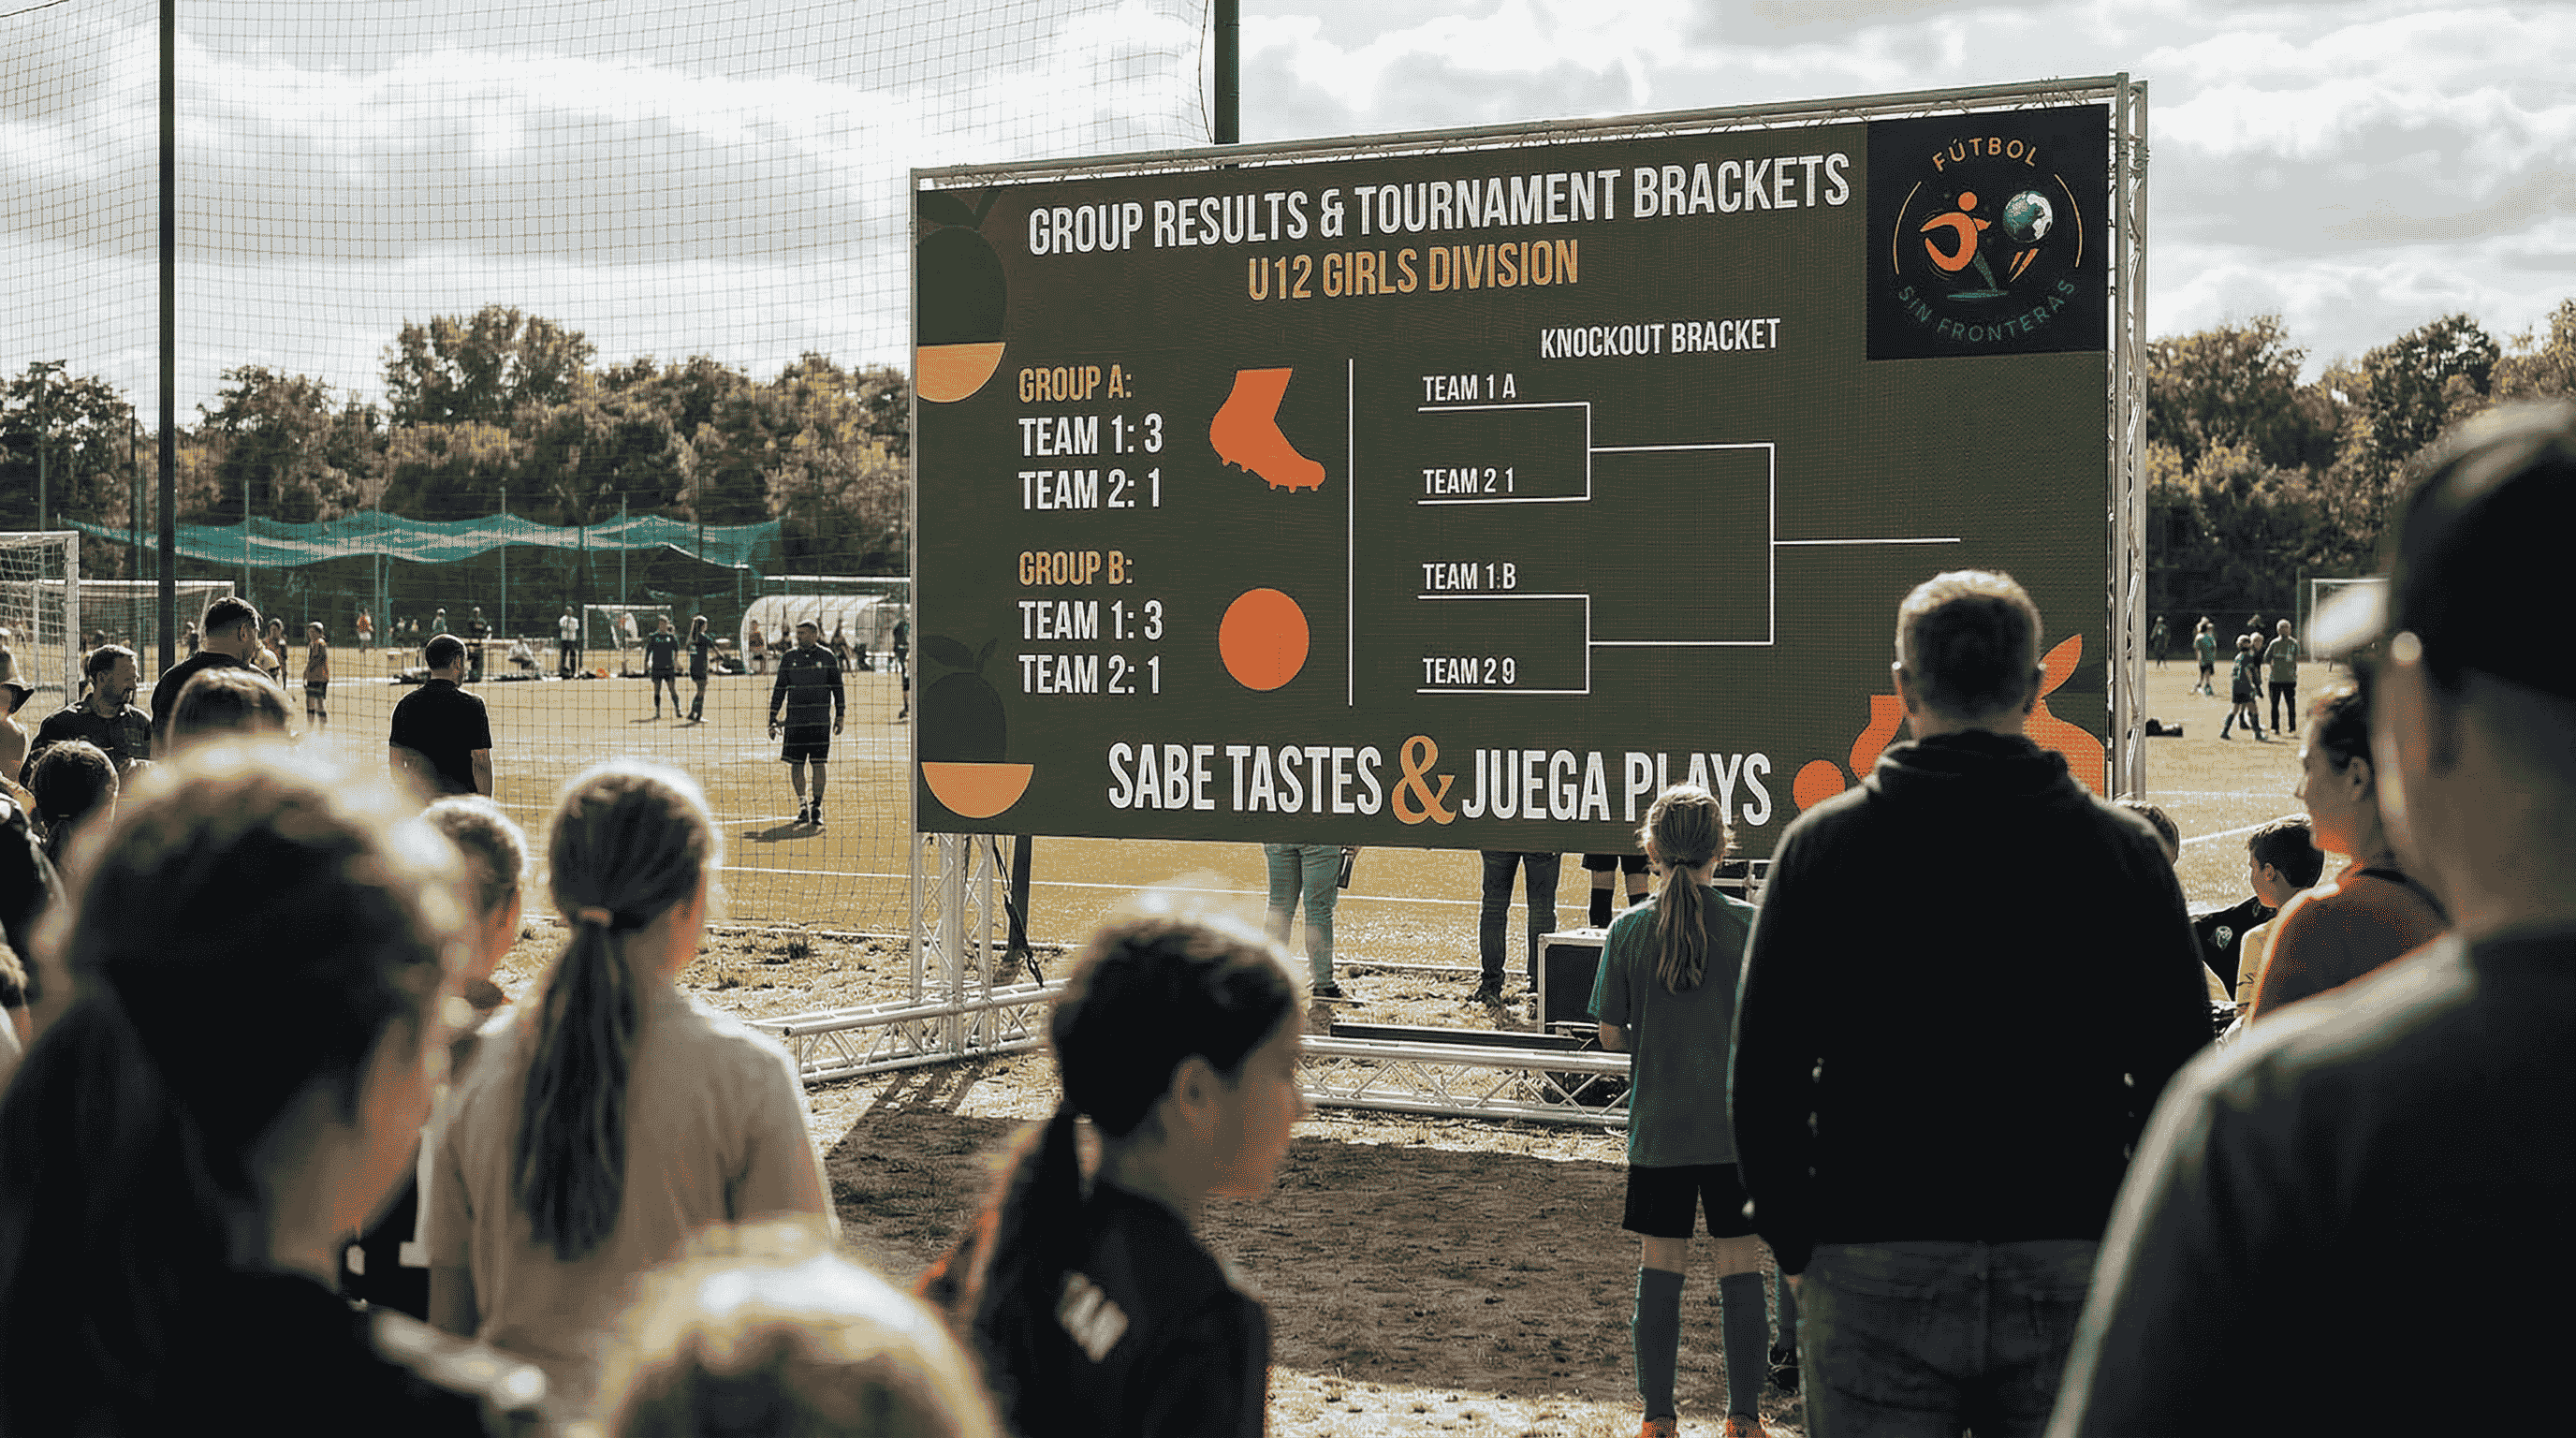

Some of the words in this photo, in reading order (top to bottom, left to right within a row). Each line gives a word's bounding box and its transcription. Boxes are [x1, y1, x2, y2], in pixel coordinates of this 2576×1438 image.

[1932, 137, 2037, 172] FÚTBOL
[1029, 202, 1143, 256] GROUP
[1153, 190, 1310, 248] RESULTS
[1320, 188, 1345, 238] &
[1354, 168, 1621, 235] TOURNAMENT
[1633, 152, 1851, 219] BRACKETS
[1248, 254, 1312, 301] U12
[1323, 248, 1418, 298] GIRLS
[1428, 239, 1578, 292] DIVISION
[1899, 286, 1932, 322] SIN
[1938, 280, 2074, 341] FRONTERAS
[1541, 323, 1665, 359] KNOCKOUT
[1671, 317, 1781, 354] BRACKET
[1018, 365, 1101, 404] GROUP
[1107, 364, 1133, 399] A:
[1422, 374, 1478, 402] TEAM
[1486, 374, 1495, 400] 1
[1501, 373, 1516, 399] A
[1017, 416, 1099, 457] TEAM
[1111, 414, 1135, 455] 1:
[1144, 413, 1164, 454] 3
[1017, 469, 1098, 510] TEAM
[1107, 468, 1136, 509] 2:
[1148, 467, 1161, 507] 1
[1422, 467, 1478, 494] TEAM
[1484, 467, 1497, 493] 2
[1505, 466, 1514, 492] 1
[1018, 550, 1102, 586] GROUP
[1108, 550, 1134, 585] B:
[1422, 562, 1478, 590] TEAM
[1018, 600, 1098, 640] TEAM
[1110, 599, 1135, 639] 1:
[1144, 599, 1164, 640] 3
[1017, 654, 1098, 695] TEAM
[1108, 654, 1136, 695] 2:
[1147, 655, 1161, 694] 1
[1422, 657, 1478, 684] TEAM
[1484, 657, 1497, 684] 2
[1501, 657, 1515, 684] 9
[1108, 741, 1215, 811] SABE
[1225, 745, 1383, 814] TASTES
[1391, 735, 1457, 825] &
[1461, 749, 1611, 822] JUEGA
